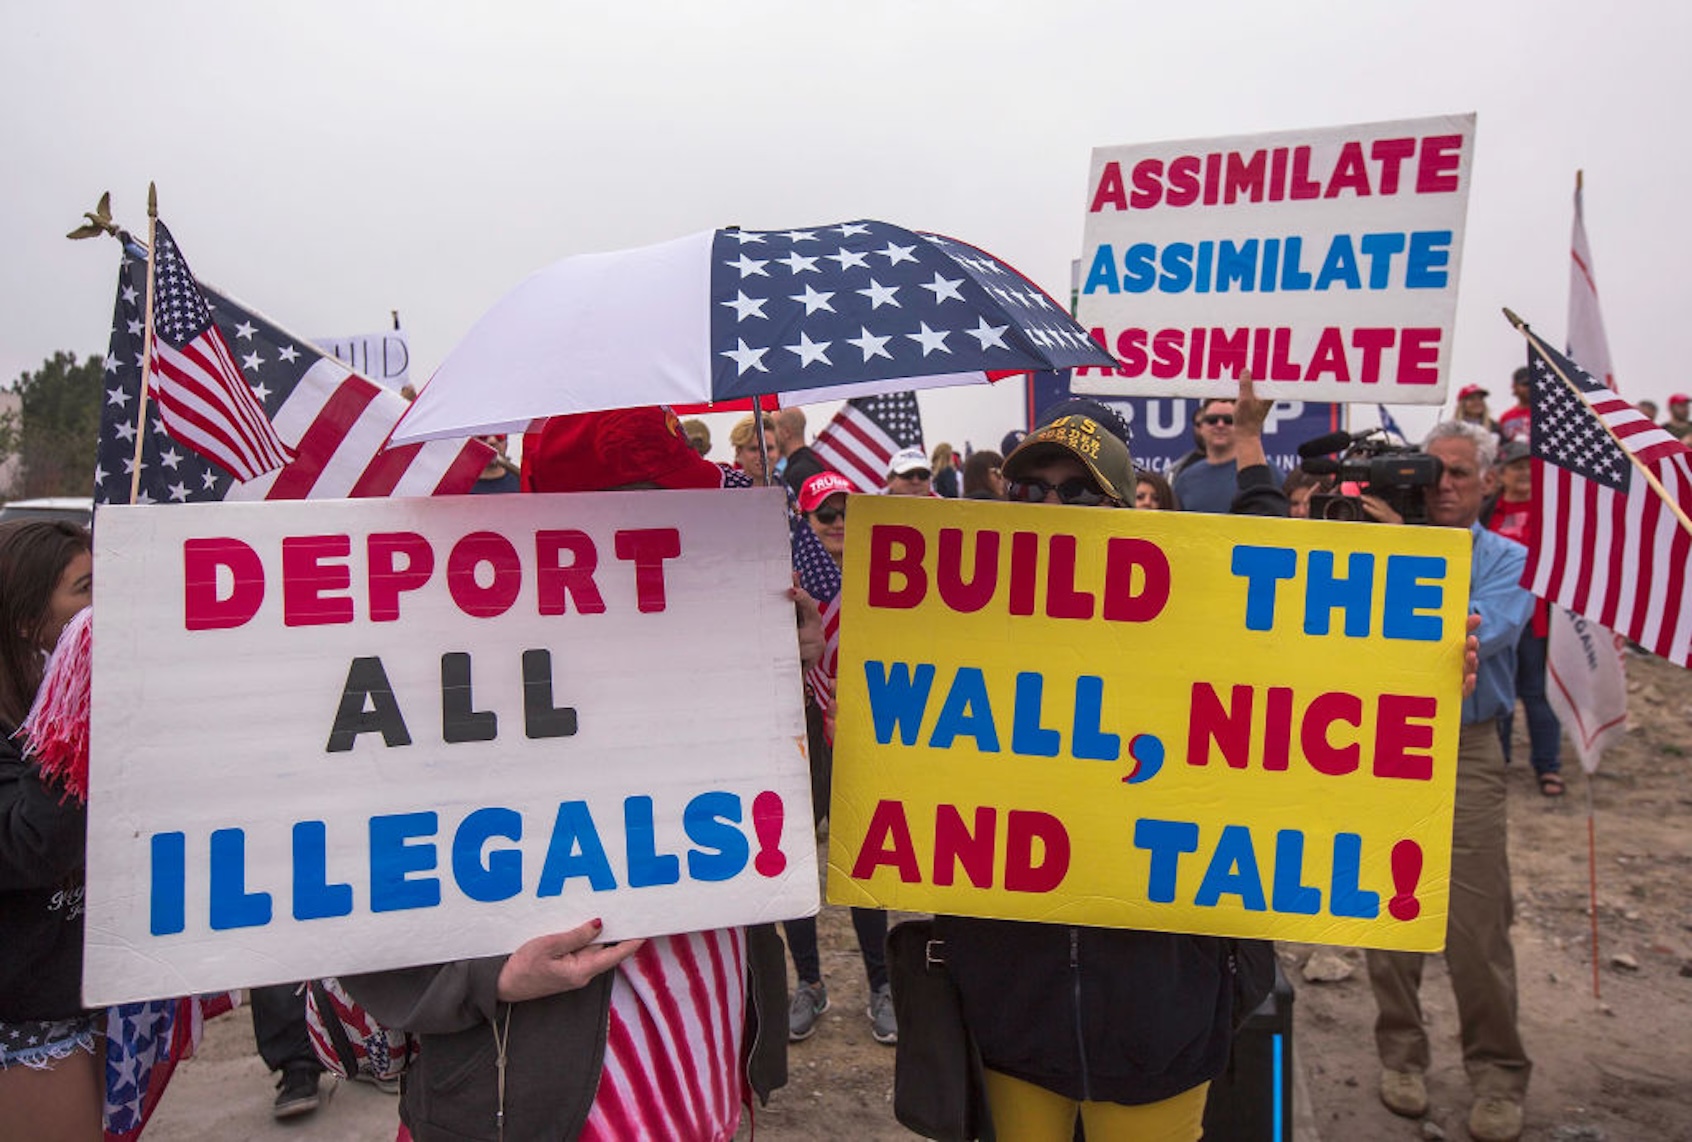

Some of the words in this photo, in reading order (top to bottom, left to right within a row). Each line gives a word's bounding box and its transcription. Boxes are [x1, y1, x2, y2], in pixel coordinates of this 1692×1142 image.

[1091, 135, 1463, 213] ASSIMILATE
[1083, 231, 1452, 295] ASSIMILATE
[1076, 327, 1442, 385] ASSIMILATE
[184, 528, 681, 630] DEPORT
[868, 525, 1171, 623] BUILD
[1231, 546, 1446, 641] THE
[326, 649, 579, 753] ALL
[864, 661, 1165, 784] WALL,
[1186, 682, 1437, 781] NICE
[150, 790, 787, 941] ILLEGALS!
[851, 800, 1071, 893] AND
[1134, 818, 1423, 922] TALL!
